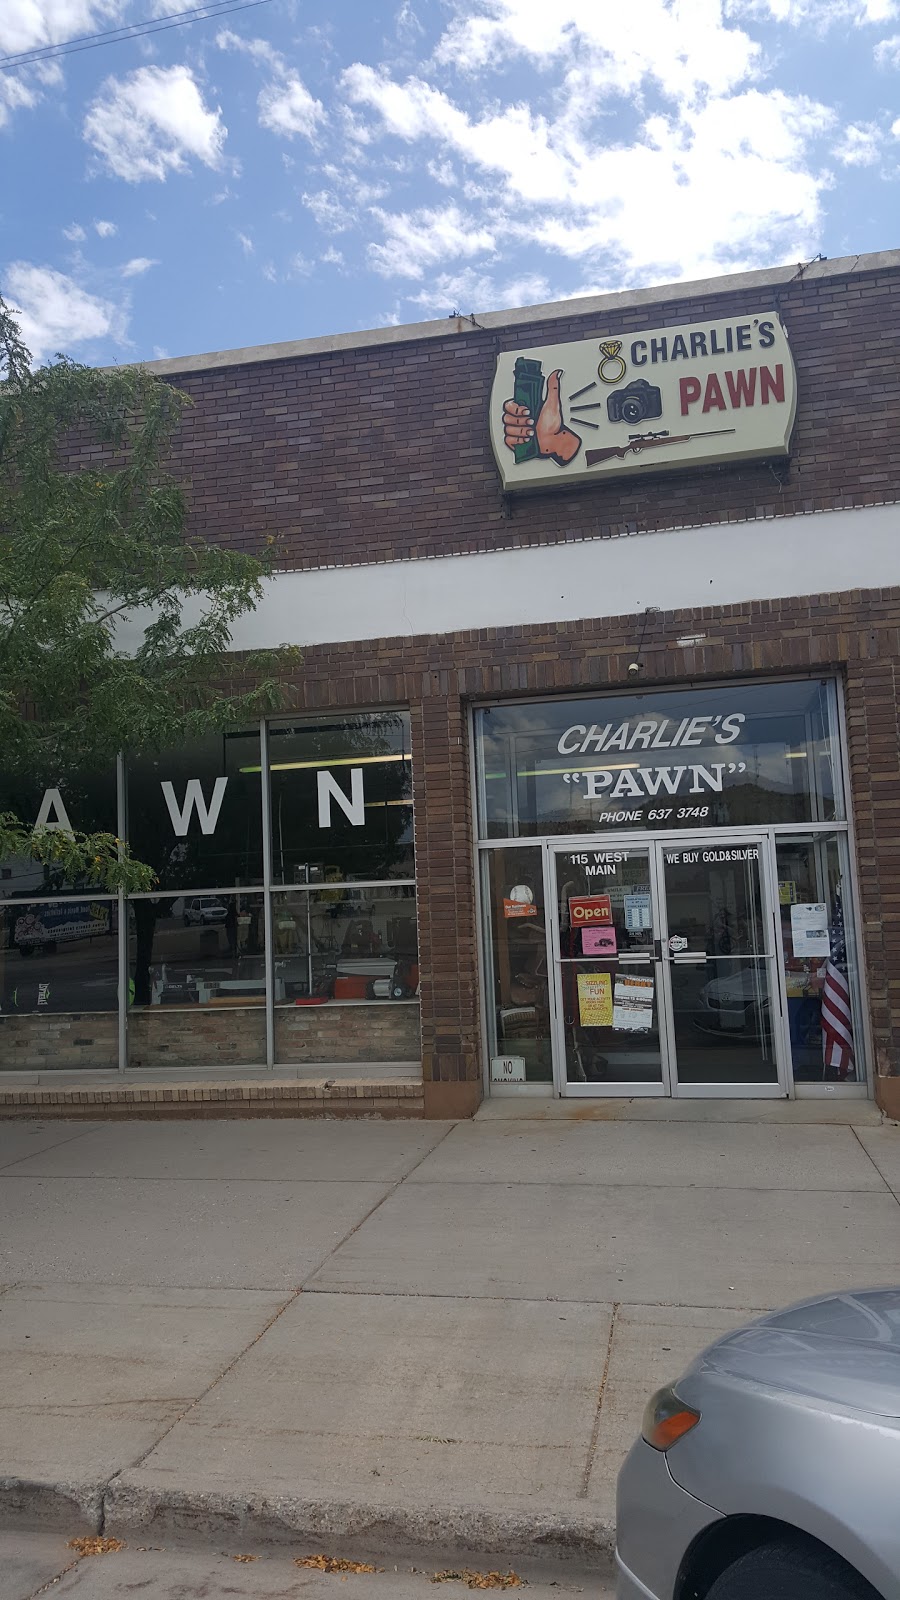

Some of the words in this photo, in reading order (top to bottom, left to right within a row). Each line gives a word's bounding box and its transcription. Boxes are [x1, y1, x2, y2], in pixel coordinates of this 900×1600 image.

[630, 319, 776, 367] CHARLIE'S
[679, 363, 786, 416] PAWN
[557, 713, 746, 755] CHARLIE'S
[160, 777, 229, 836] W
[316, 768, 366, 828] N
[599, 810, 643, 823] PHONE
[647, 808, 673, 820] 637
[676, 806, 709, 819] 3748
[570, 854, 589, 865] 115
[593, 851, 630, 863] WEST
[666, 853, 680, 864] WE
[682, 852, 699, 863] BUY
[702, 849, 759, 862] GOLD&SILVER
[585, 864, 617, 876] MAIN
[573, 906, 609, 920] Open
[503, 1061, 513, 1074] NO
